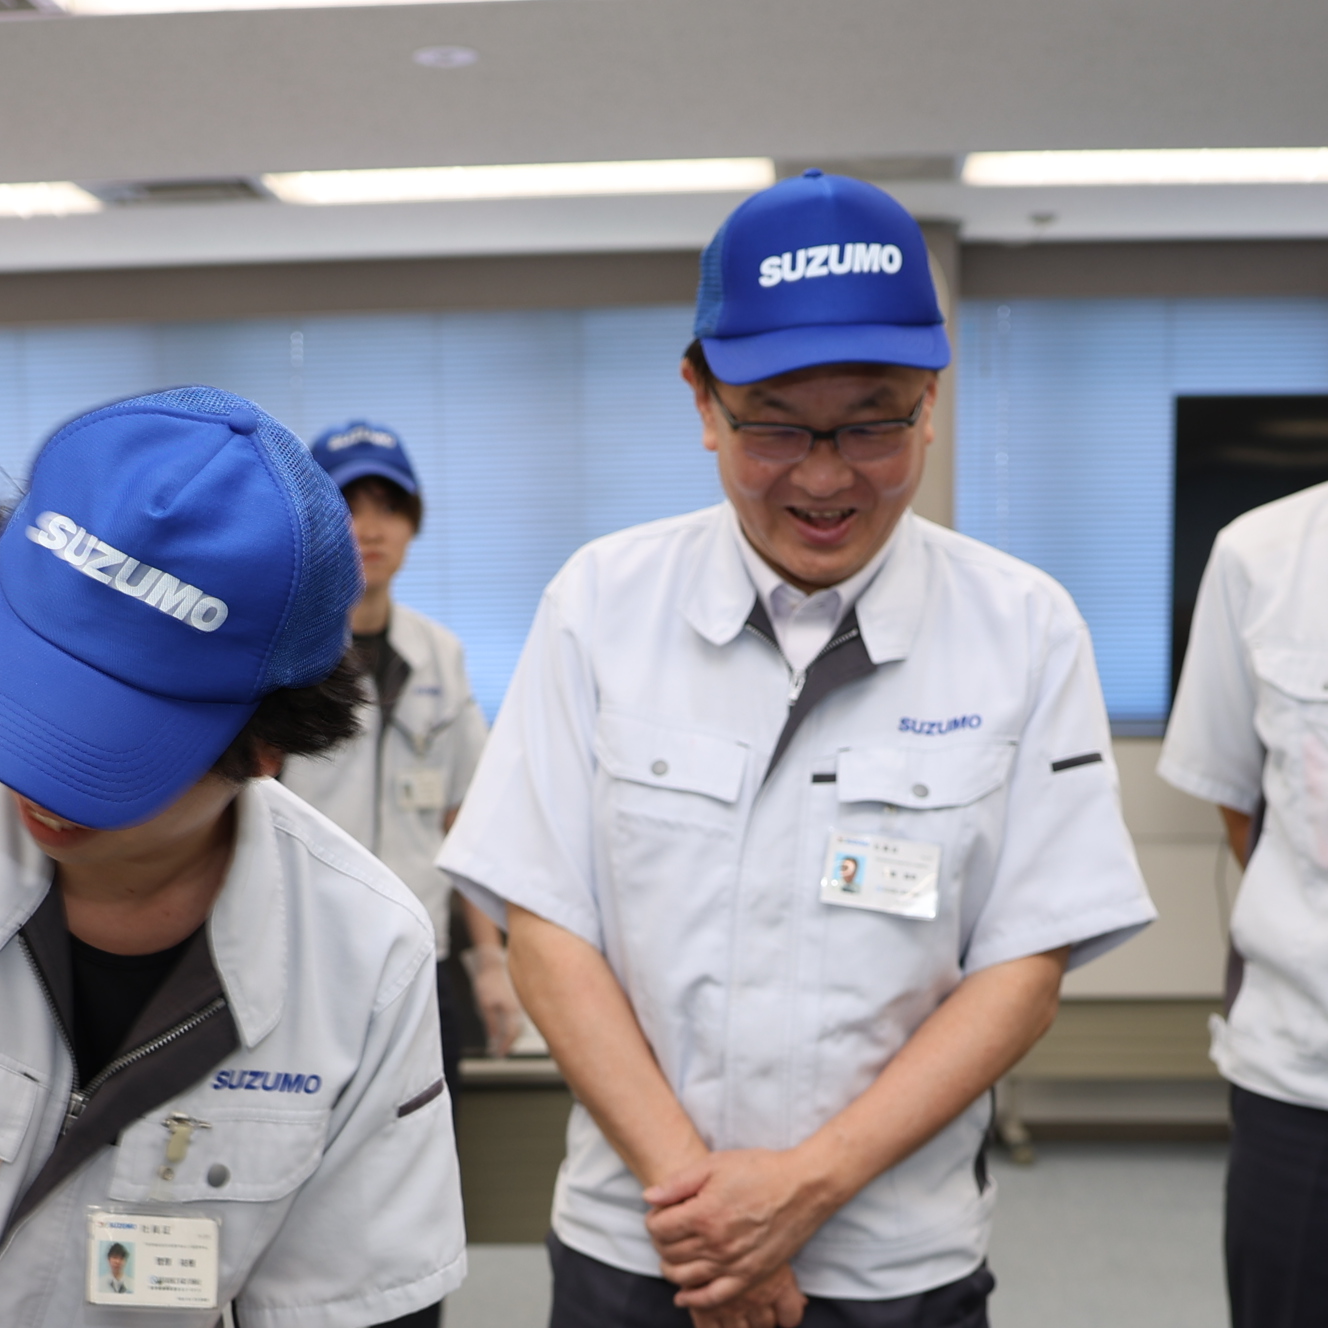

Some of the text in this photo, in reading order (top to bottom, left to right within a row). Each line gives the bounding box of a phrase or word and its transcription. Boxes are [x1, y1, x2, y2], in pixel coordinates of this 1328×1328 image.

[758, 242, 903, 288] SUZUMO
[29, 512, 229, 632] SUZUMO
[898, 714, 982, 735] SUZUMO
[212, 1070, 322, 1094] SUZUMO
